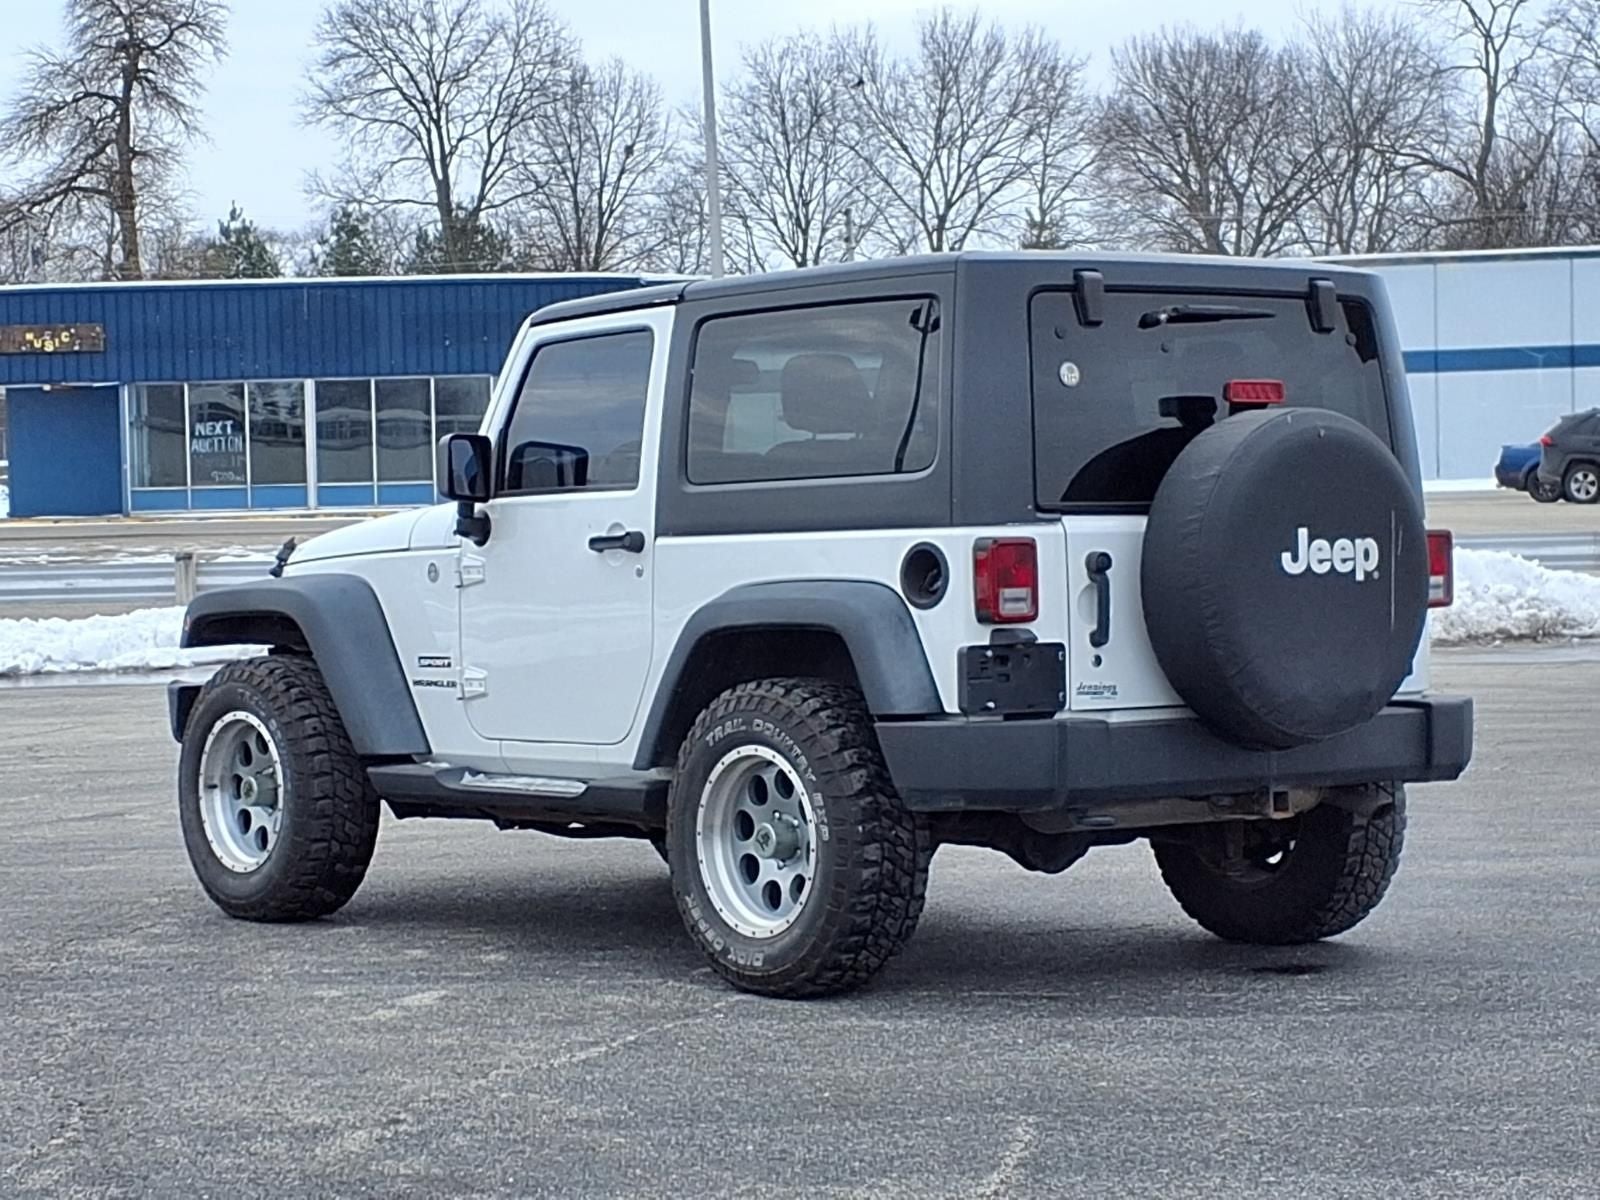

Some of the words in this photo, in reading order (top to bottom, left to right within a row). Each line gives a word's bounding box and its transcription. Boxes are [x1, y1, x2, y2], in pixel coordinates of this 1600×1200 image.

[195, 420, 234, 436] NEXT
[1281, 527, 1379, 581] Jeep
[418, 657, 451, 668] SPORT
[413, 679, 457, 688] WRANGLER
[705, 718, 747, 747] TRAIL
